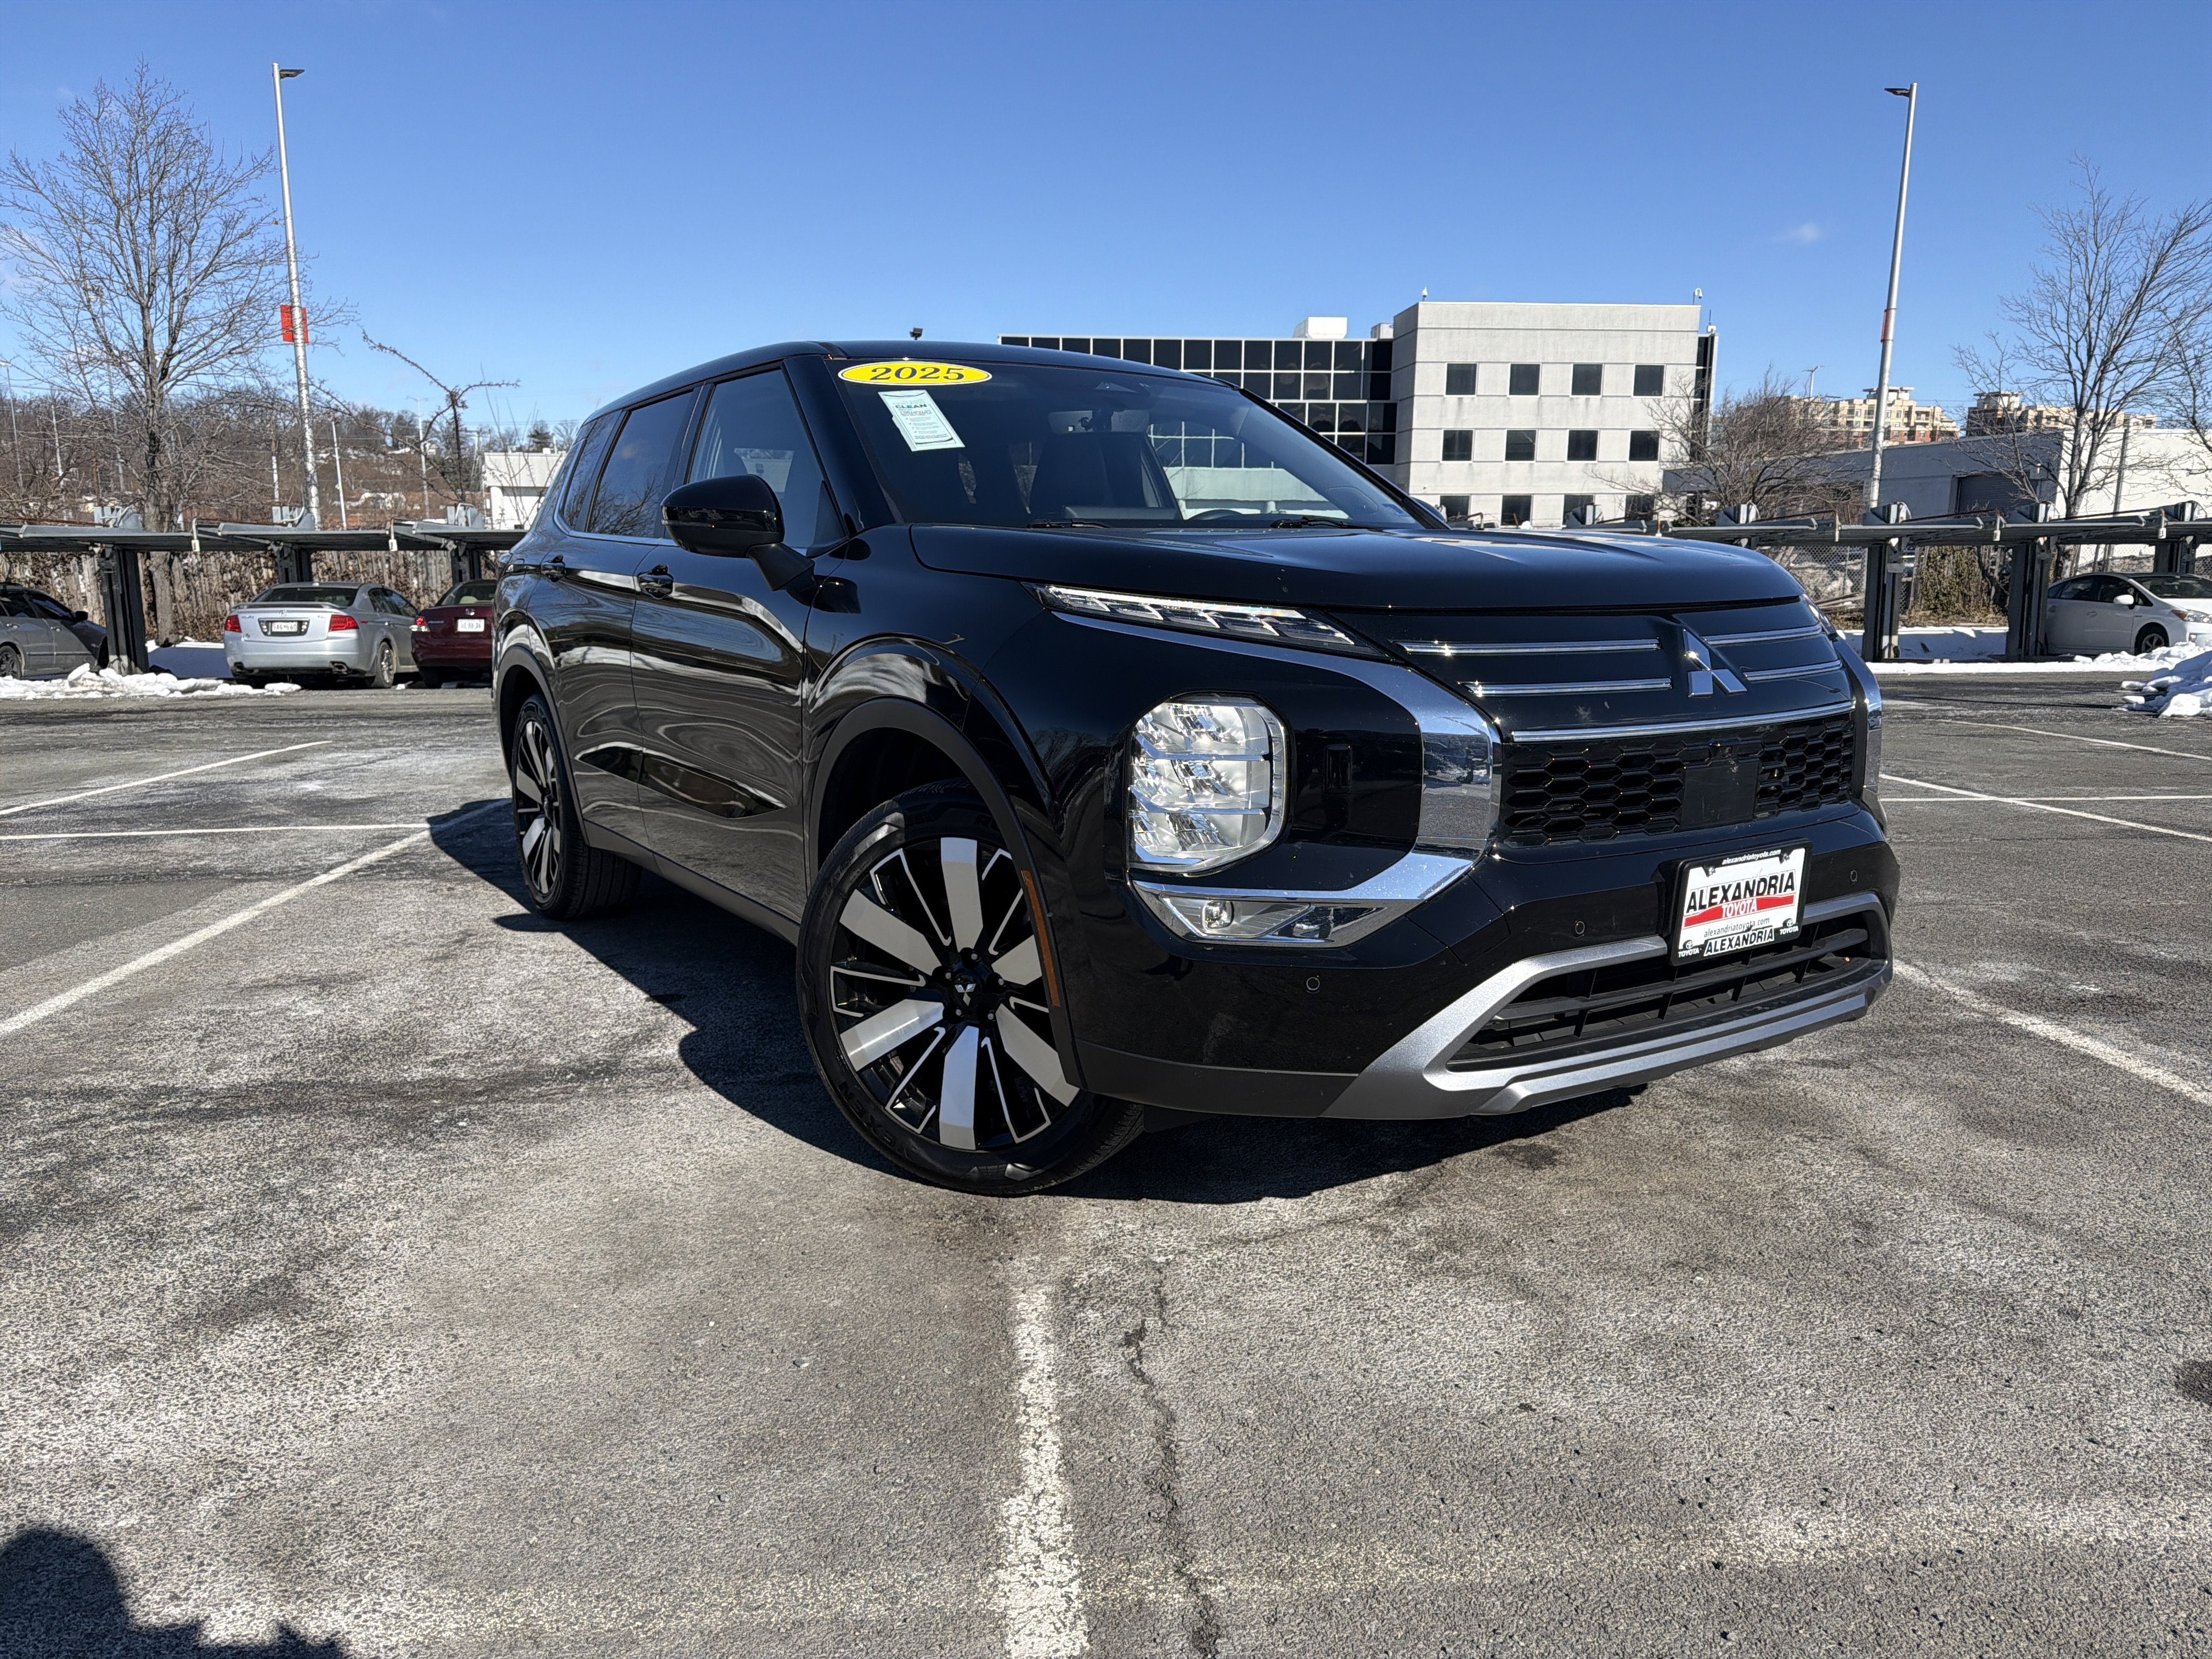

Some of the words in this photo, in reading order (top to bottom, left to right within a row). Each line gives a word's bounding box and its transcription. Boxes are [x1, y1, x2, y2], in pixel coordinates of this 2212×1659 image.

[870, 366, 964, 381] 2025
[1722, 849, 1781, 865] alexandriatoyota.com
[1686, 871, 1795, 914] ALEXANDRIA
[1722, 898, 1758, 919] TOYOTA
[1703, 917, 1770, 938] alexandriatoyota.com
[1779, 926, 1799, 935] TOYOTA
[1703, 928, 1774, 956] ALEXANDRIA
[1678, 947, 1700, 958] TOYOTA
